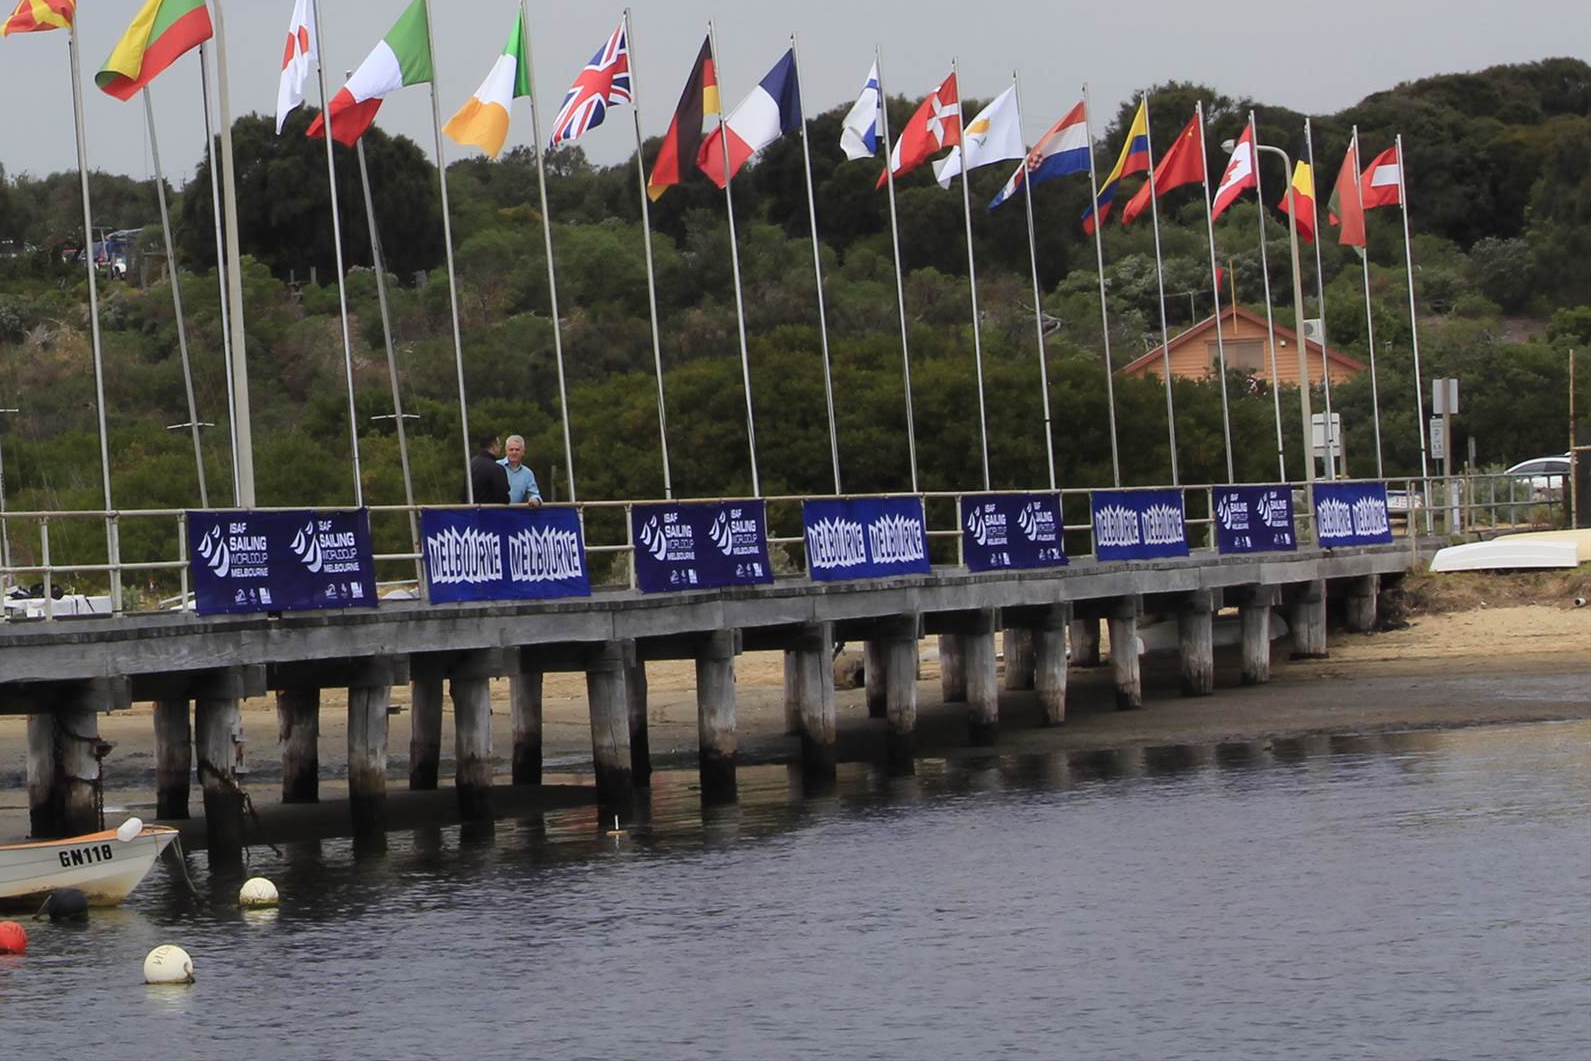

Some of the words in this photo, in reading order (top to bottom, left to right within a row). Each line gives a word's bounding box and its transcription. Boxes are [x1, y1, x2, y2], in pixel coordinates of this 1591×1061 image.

[229, 522, 247, 534] ISAF
[229, 536, 266, 551] SAILING
[320, 532, 355, 548] SAILING
[427, 526, 502, 583] MELBOURNE
[508, 526, 582, 581] MELBOURNE
[231, 567, 268, 578] MELBOURNE
[323, 562, 360, 573] MELBOURNE
[59, 844, 112, 867] GN118
